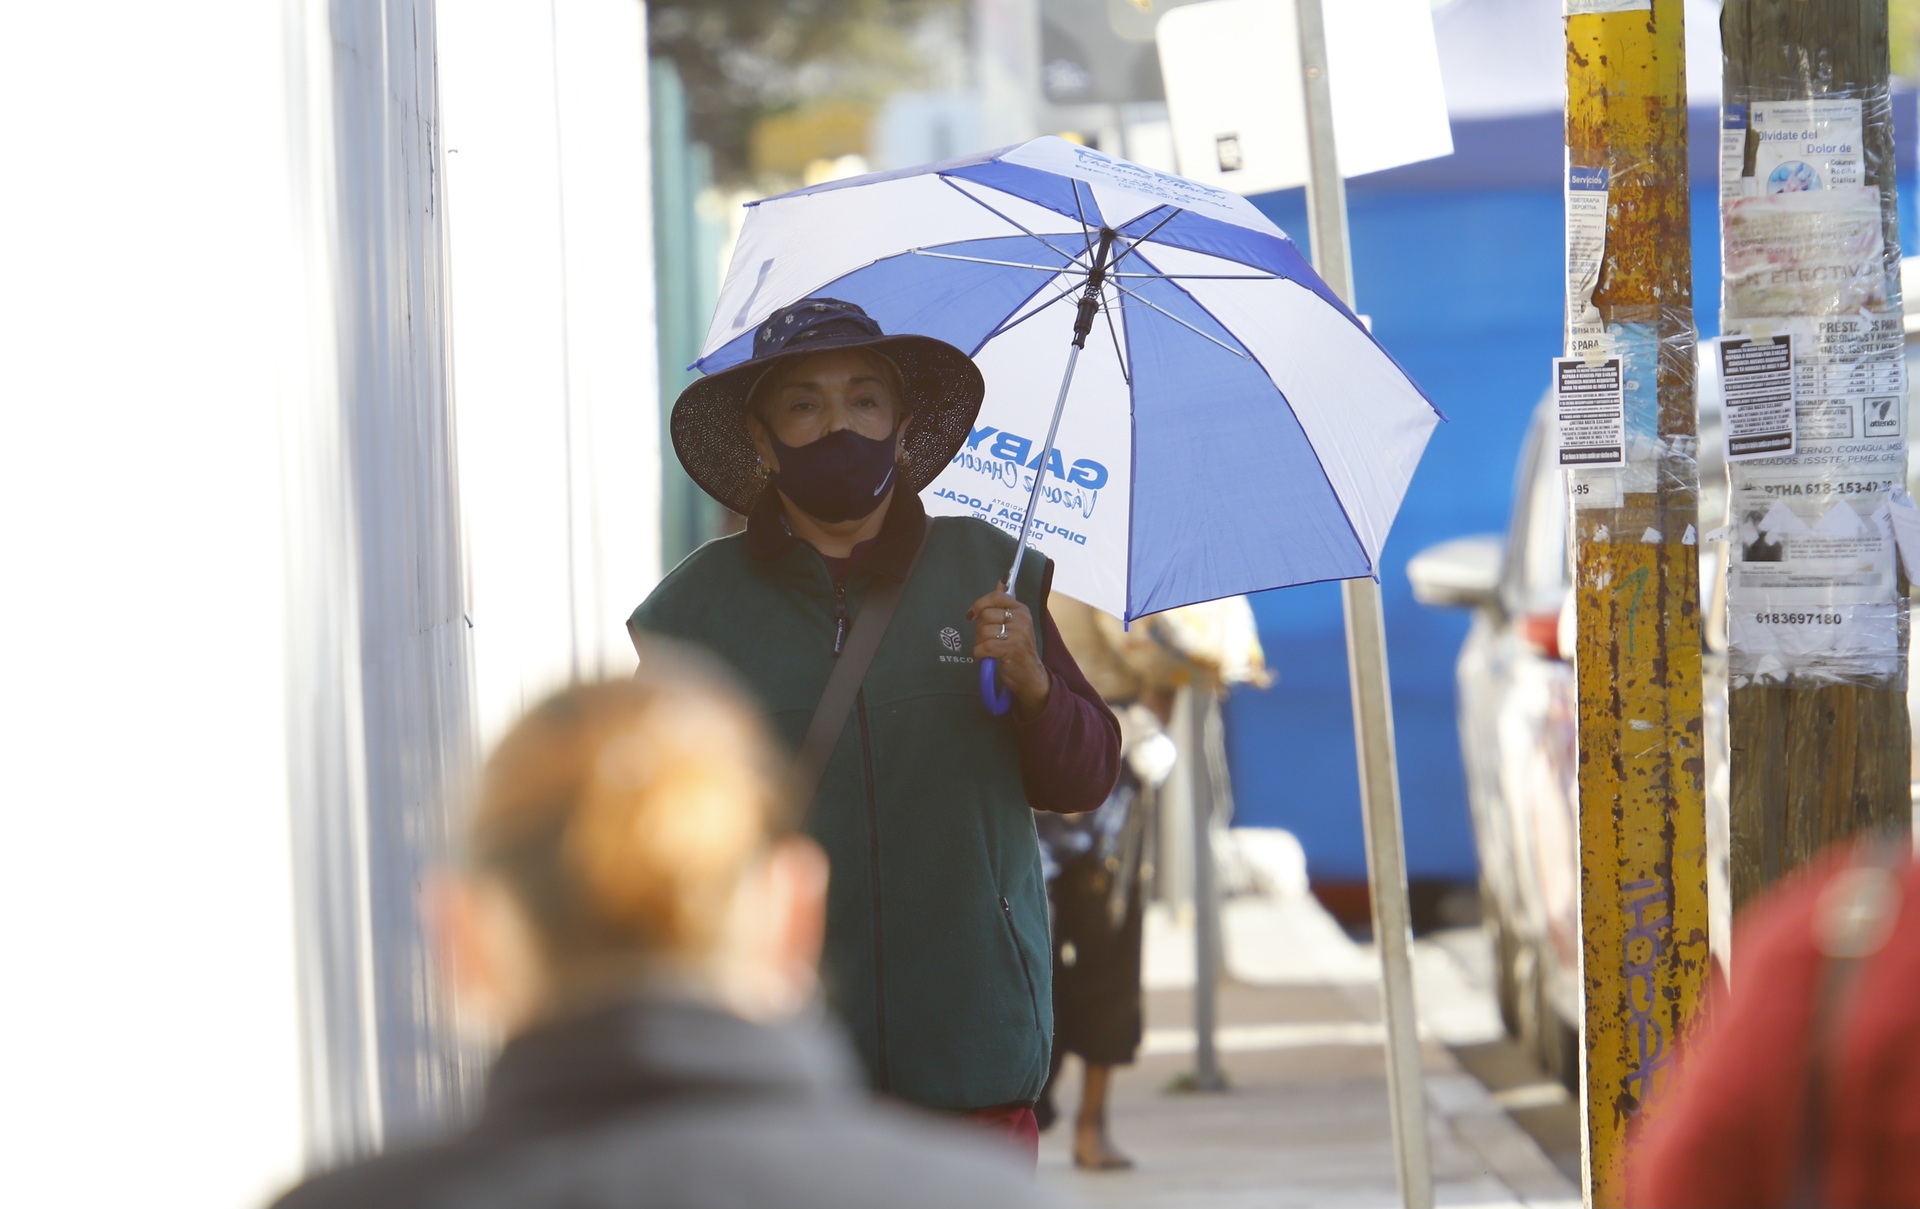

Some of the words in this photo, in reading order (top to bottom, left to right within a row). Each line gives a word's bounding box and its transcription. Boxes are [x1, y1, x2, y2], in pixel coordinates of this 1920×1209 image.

[1801, 129, 1818, 140] del
[1807, 143, 1836, 154] Dolor
[1839, 143, 1852, 153] de
[1571, 175, 1602, 186] Servicios
[1578, 340, 1599, 350] PARA
[1755, 613, 1843, 625] 6183697180
[939, 655, 975, 664] SYSCO
